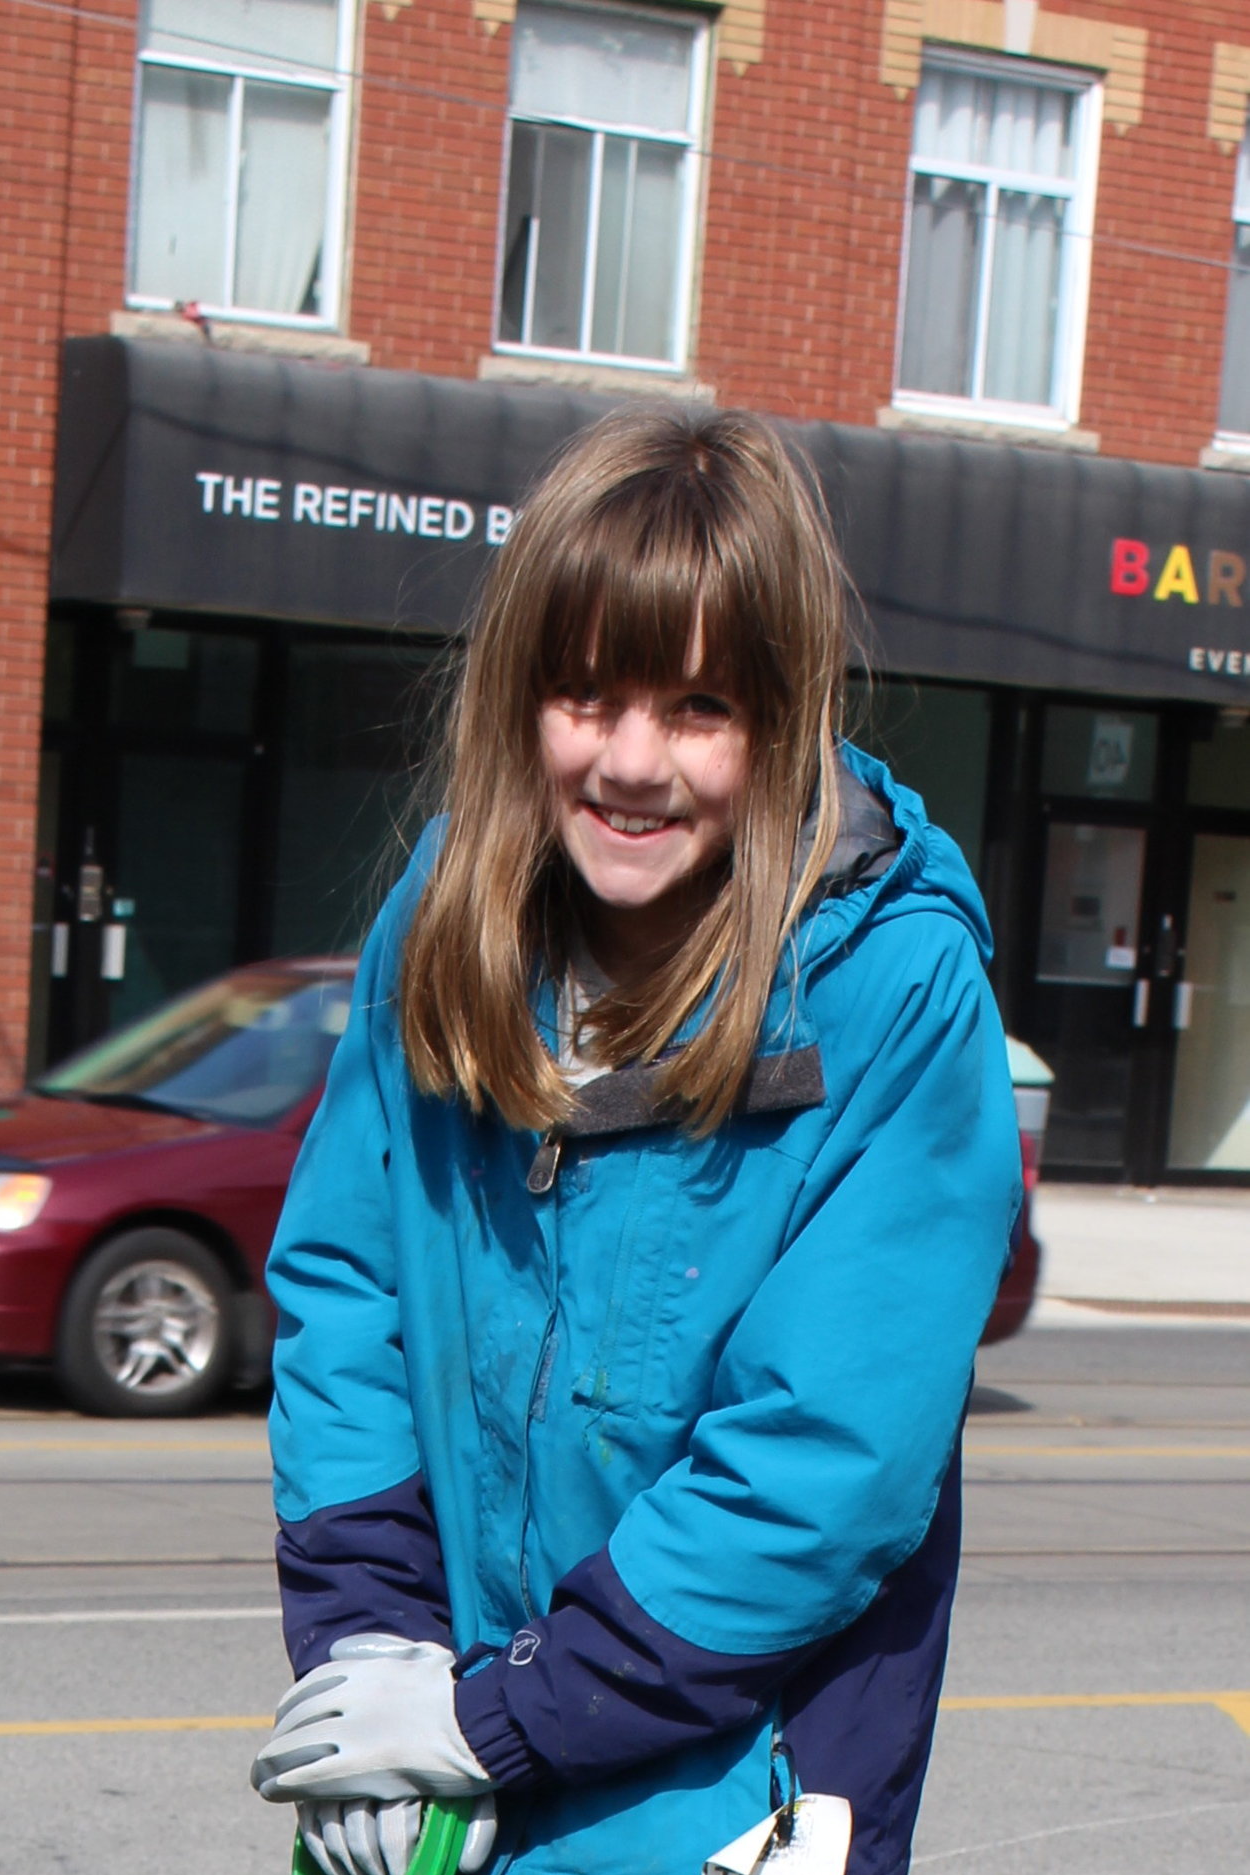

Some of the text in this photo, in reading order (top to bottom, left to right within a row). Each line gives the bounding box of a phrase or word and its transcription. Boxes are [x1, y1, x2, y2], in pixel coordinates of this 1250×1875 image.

[196, 472, 281, 520] THE
[293, 482, 475, 540] REFINED
[1109, 537, 1247, 608] BAR
